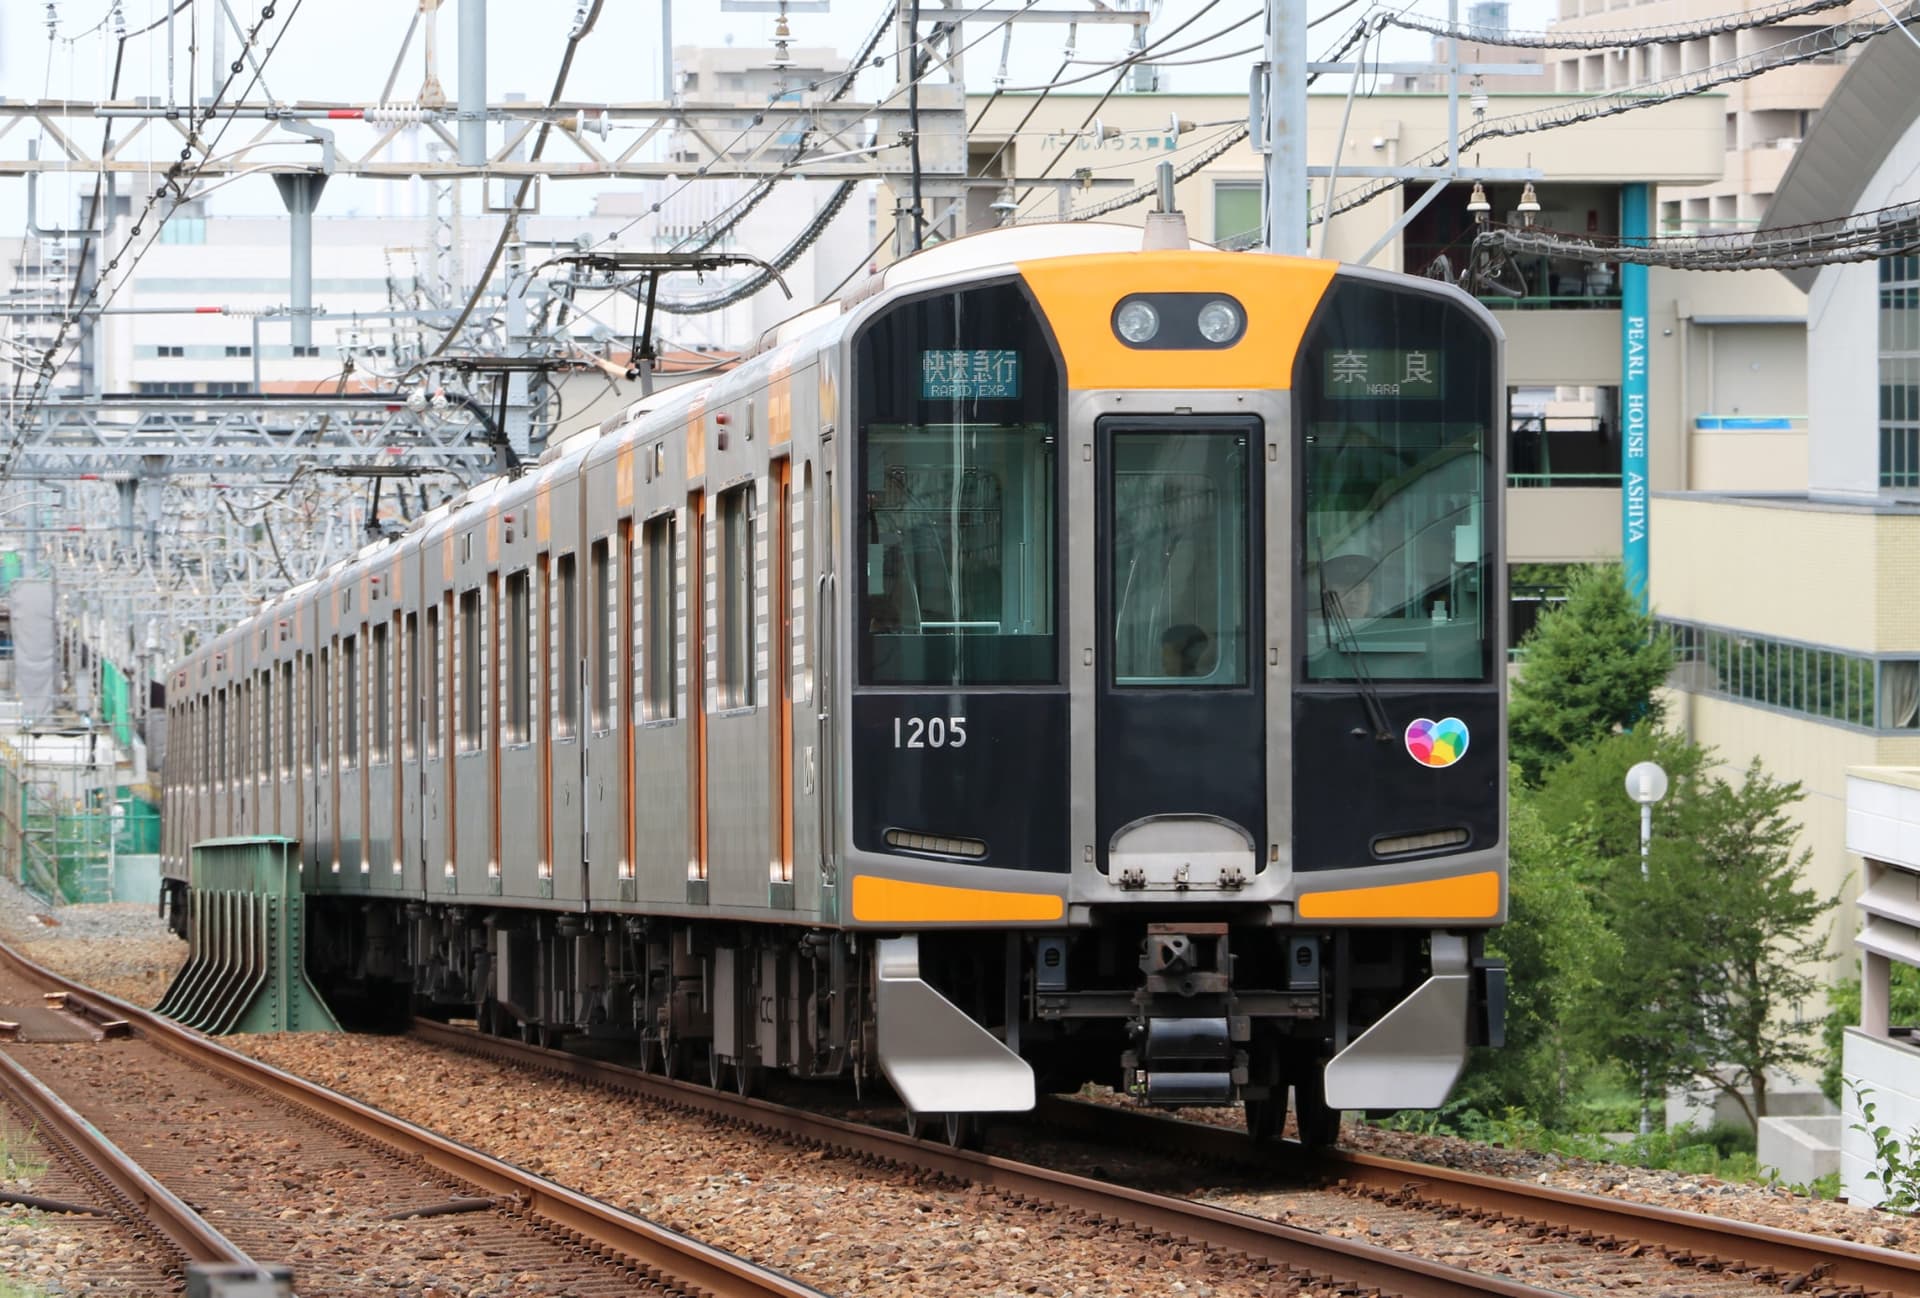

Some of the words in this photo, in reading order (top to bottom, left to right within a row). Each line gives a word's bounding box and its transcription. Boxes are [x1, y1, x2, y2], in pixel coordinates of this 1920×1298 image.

[1628, 316, 1645, 380] PEARL
[922, 350, 1017, 383] 快速急行
[1332, 350, 1433, 384] 奈良
[931, 385, 972, 397] RAPID
[979, 385, 1008, 397] EXP.
[1366, 384, 1401, 396] NARA
[1628, 394, 1645, 458] HOUSE
[1628, 472, 1645, 543] ASHIYA
[894, 716, 967, 748] 1205
